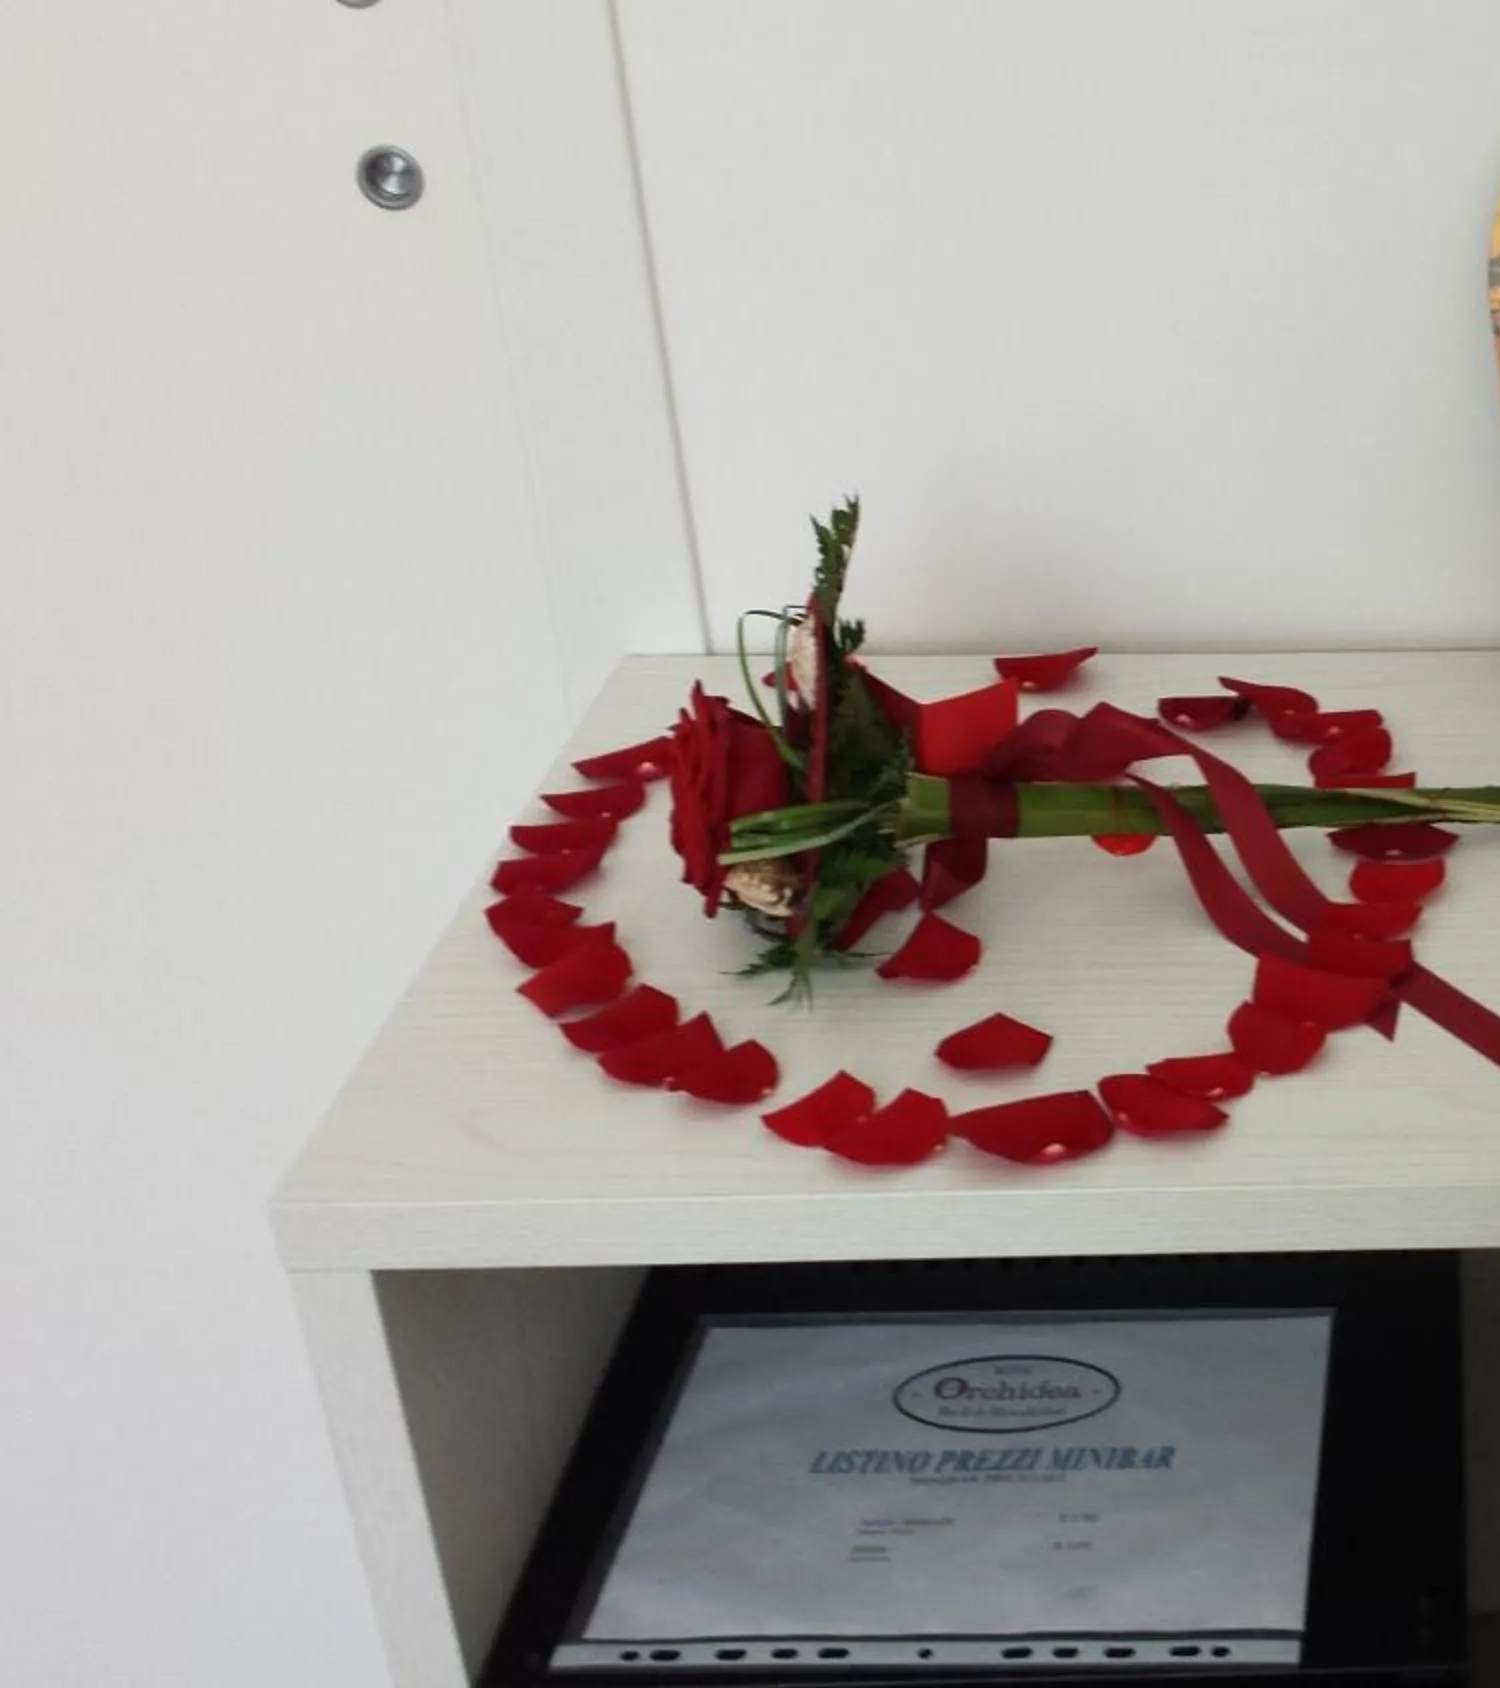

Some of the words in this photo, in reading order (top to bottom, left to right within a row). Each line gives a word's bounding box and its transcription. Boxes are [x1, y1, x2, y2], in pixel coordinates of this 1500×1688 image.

[933, 1376, 1082, 1401] Orchidea
[808, 1450, 932, 1474] LISTINO
[934, 1448, 1043, 1472] PREZZI
[1051, 1445, 1176, 1471] MINIBAR
